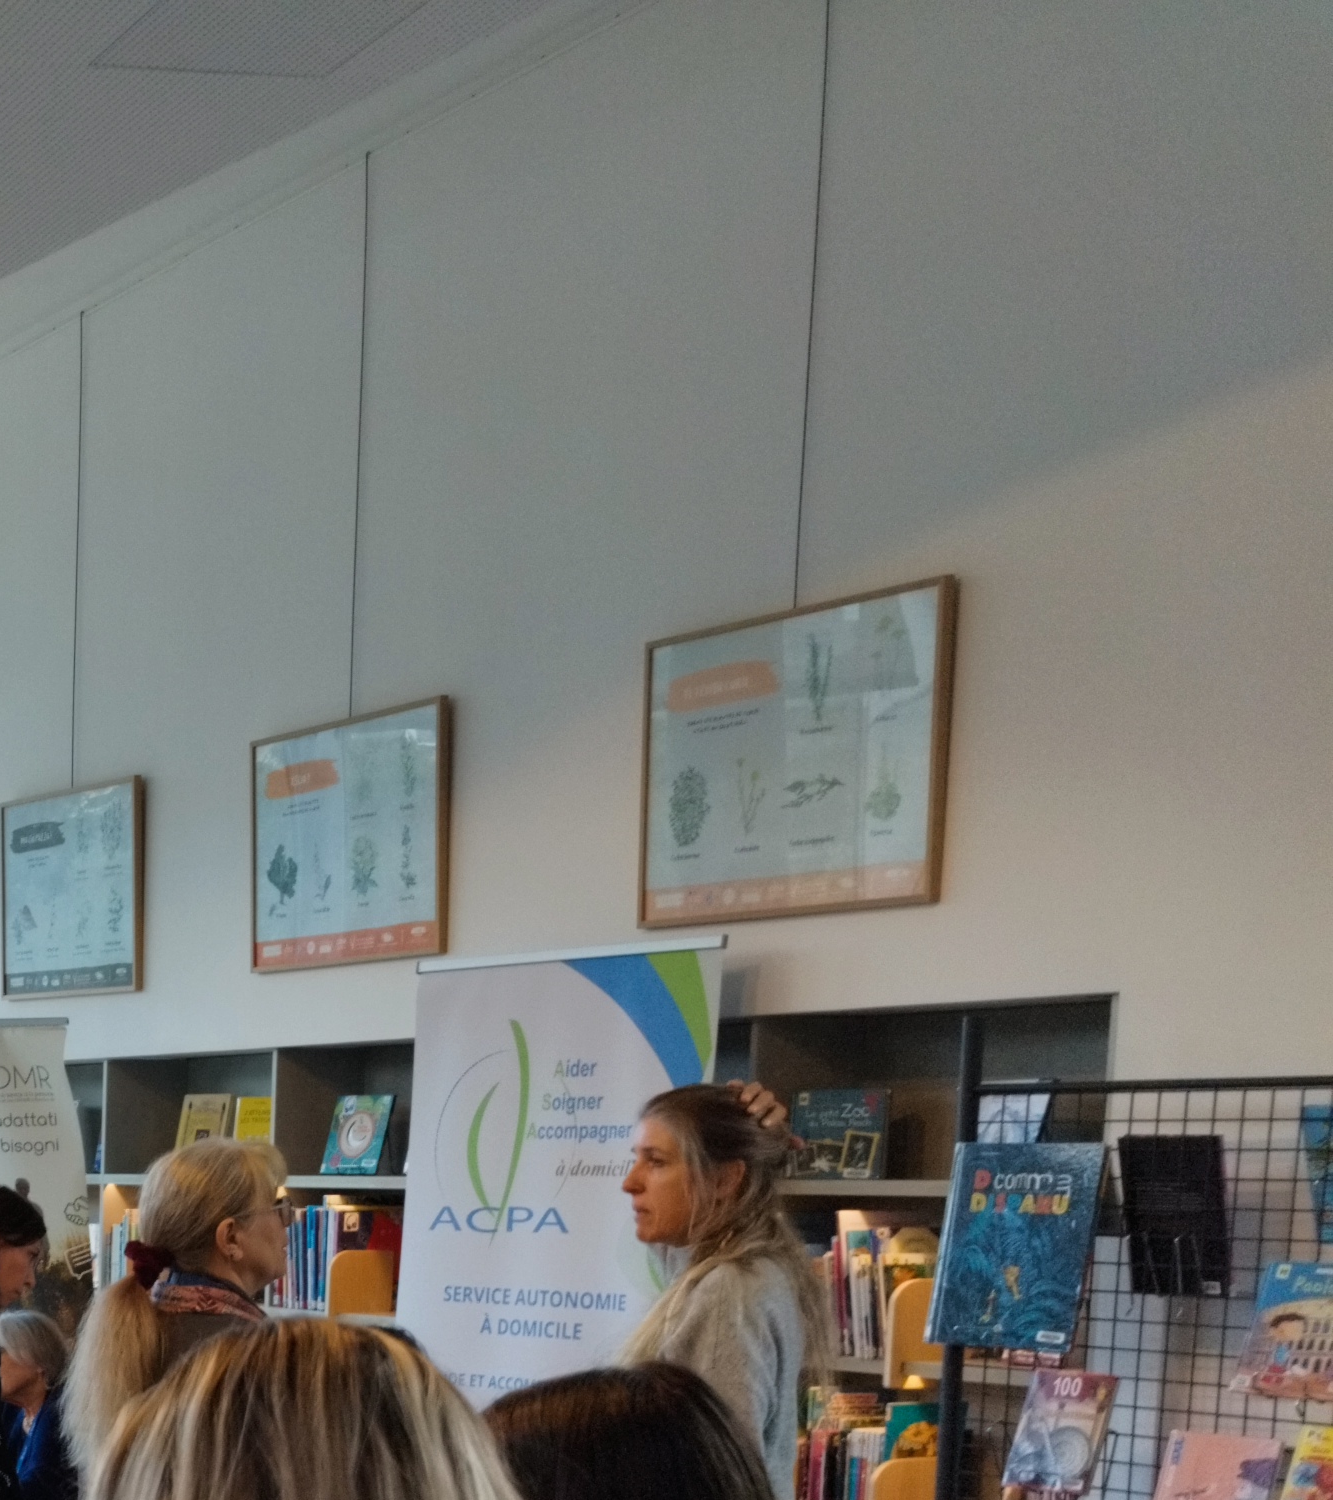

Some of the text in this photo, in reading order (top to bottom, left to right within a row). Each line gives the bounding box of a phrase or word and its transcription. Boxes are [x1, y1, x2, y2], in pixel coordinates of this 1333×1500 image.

[553, 1059, 598, 1078] Aider
[541, 1092, 605, 1115] Soigner
[526, 1122, 633, 1144] Accompagner
[0, 1138, 60, 1157] bisogni
[569, 1158, 637, 1177] domicil
[429, 1205, 569, 1236] ACPA
[443, 1284, 627, 1313] SERVICE AUTONOMIE
[497, 1316, 583, 1342] DOMICILE
[469, 1373, 485, 1388] ET
[1053, 1376, 1083, 1398] 100
